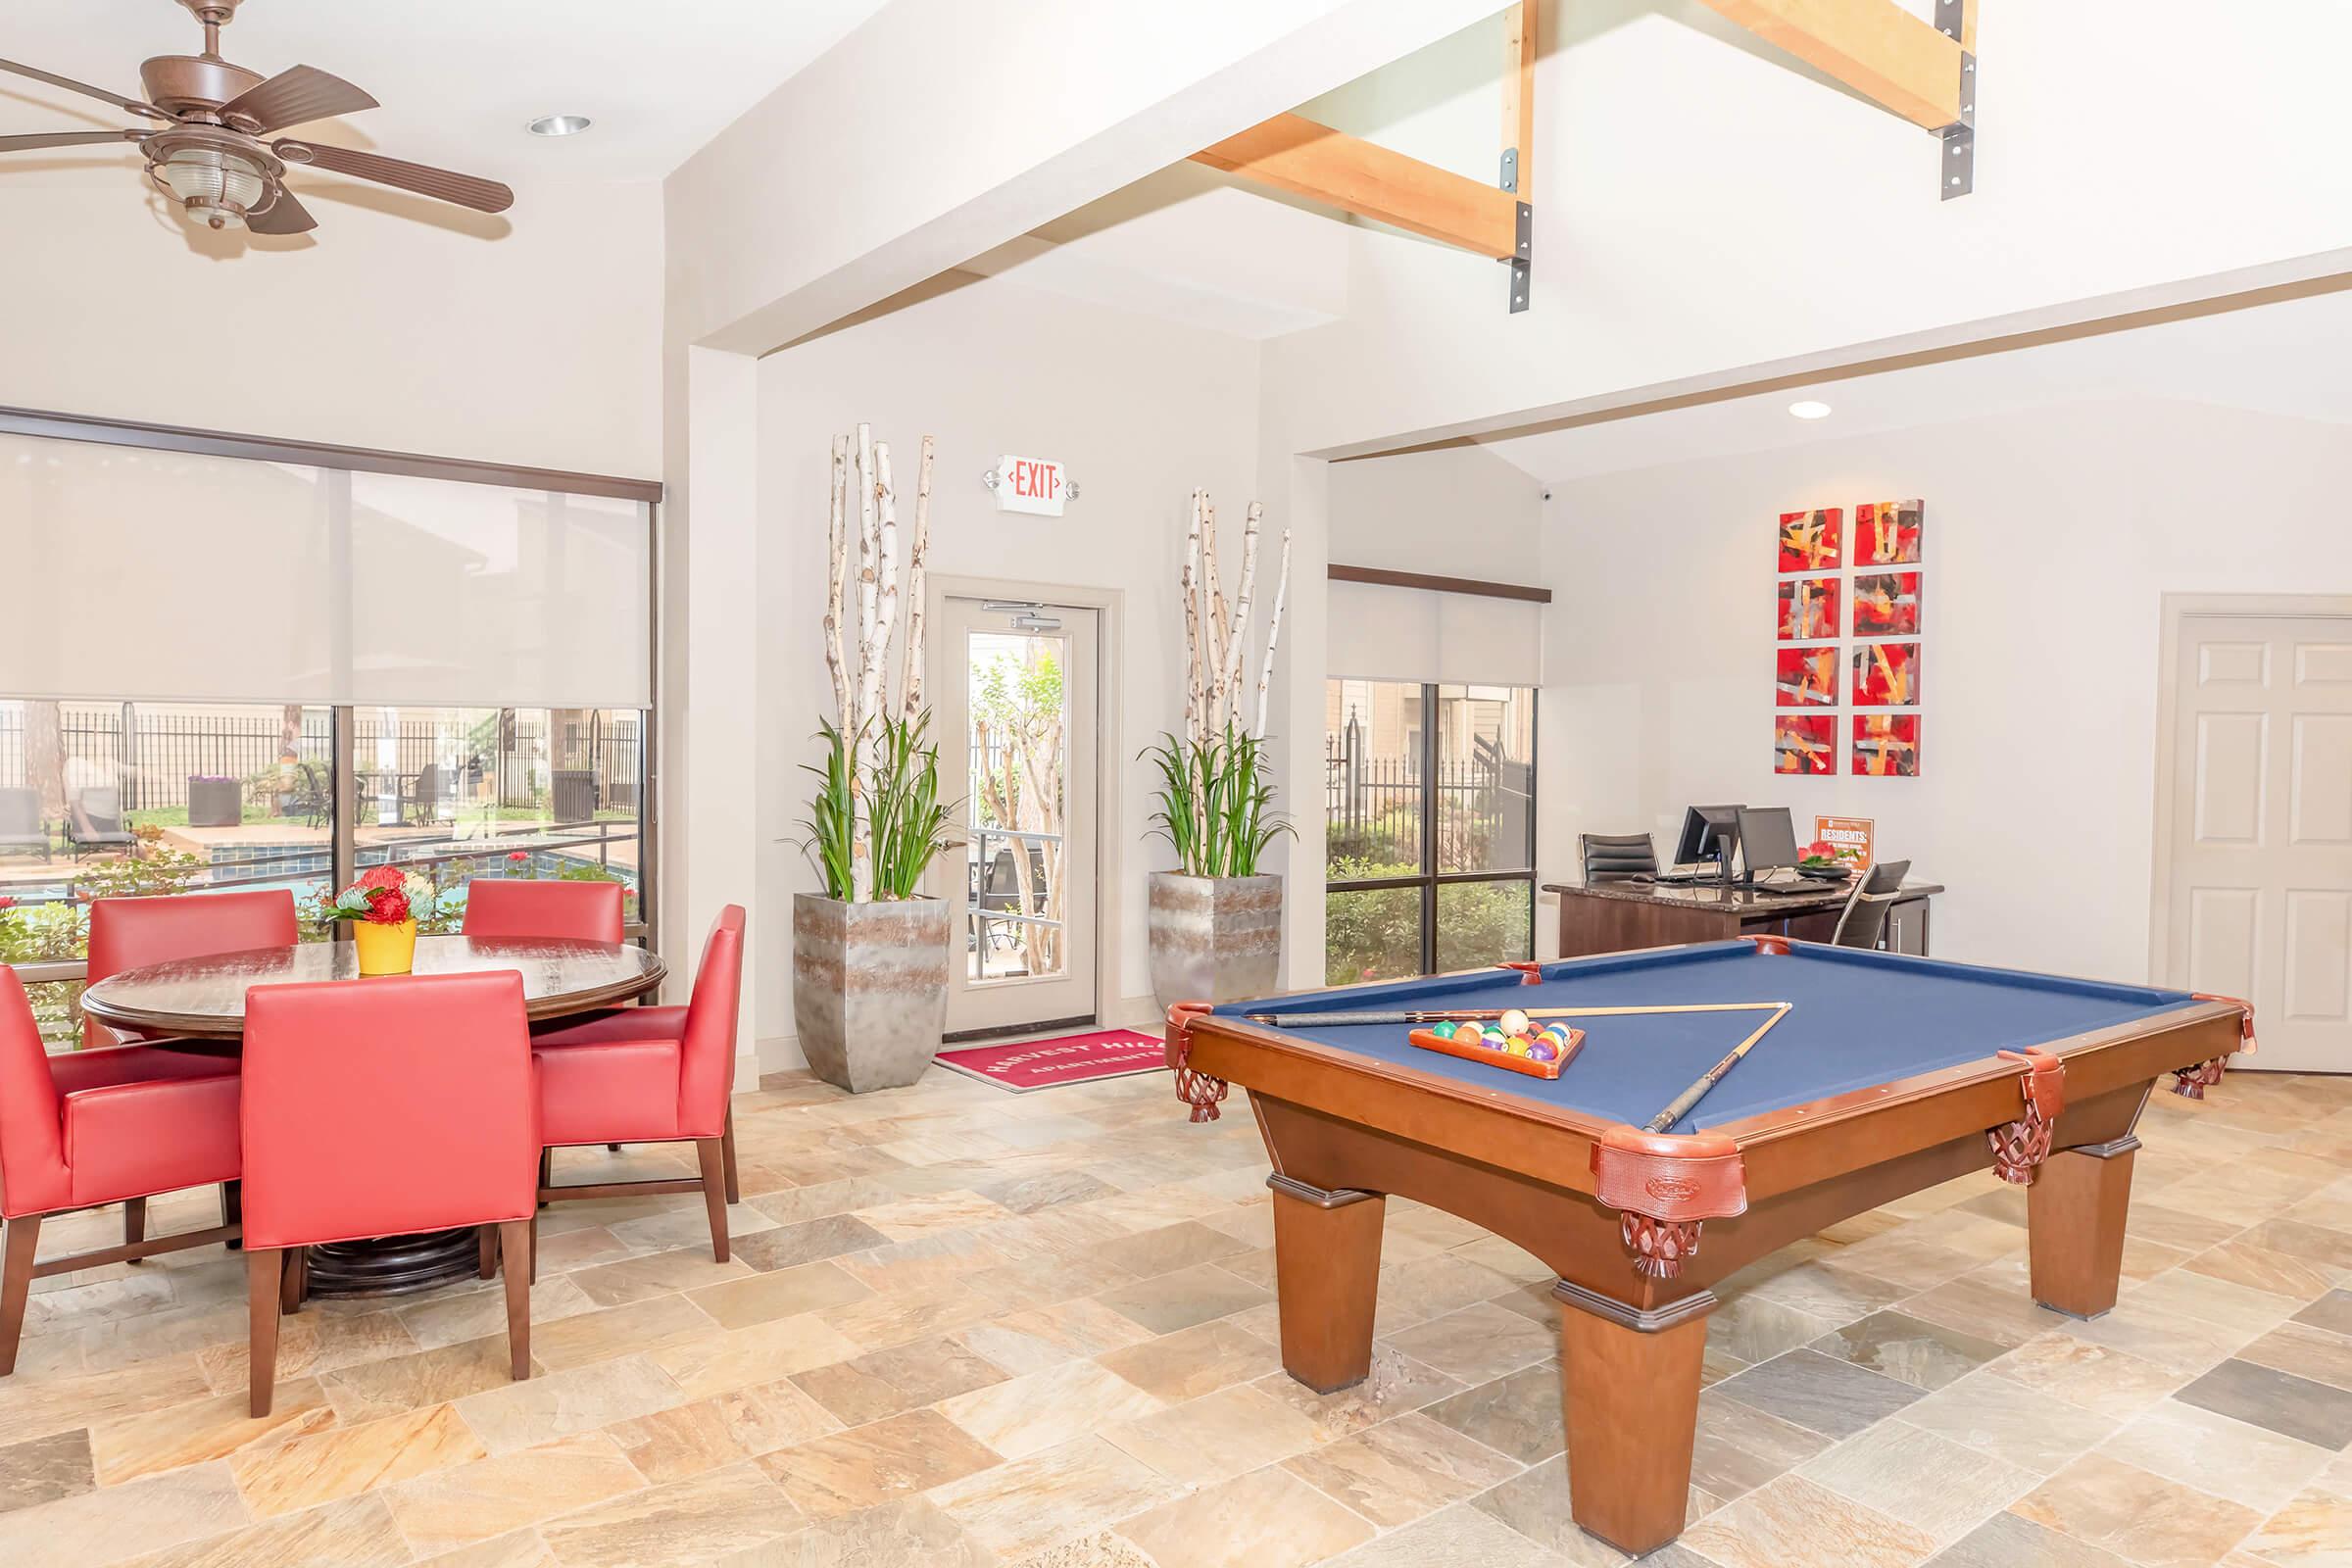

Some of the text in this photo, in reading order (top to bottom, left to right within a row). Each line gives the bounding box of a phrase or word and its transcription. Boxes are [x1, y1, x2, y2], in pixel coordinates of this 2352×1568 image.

[1015, 460, 1056, 500] EXIT
[986, 1045, 1090, 1073] HARVEST
[1030, 1052, 1164, 1074] APARTMENTS
